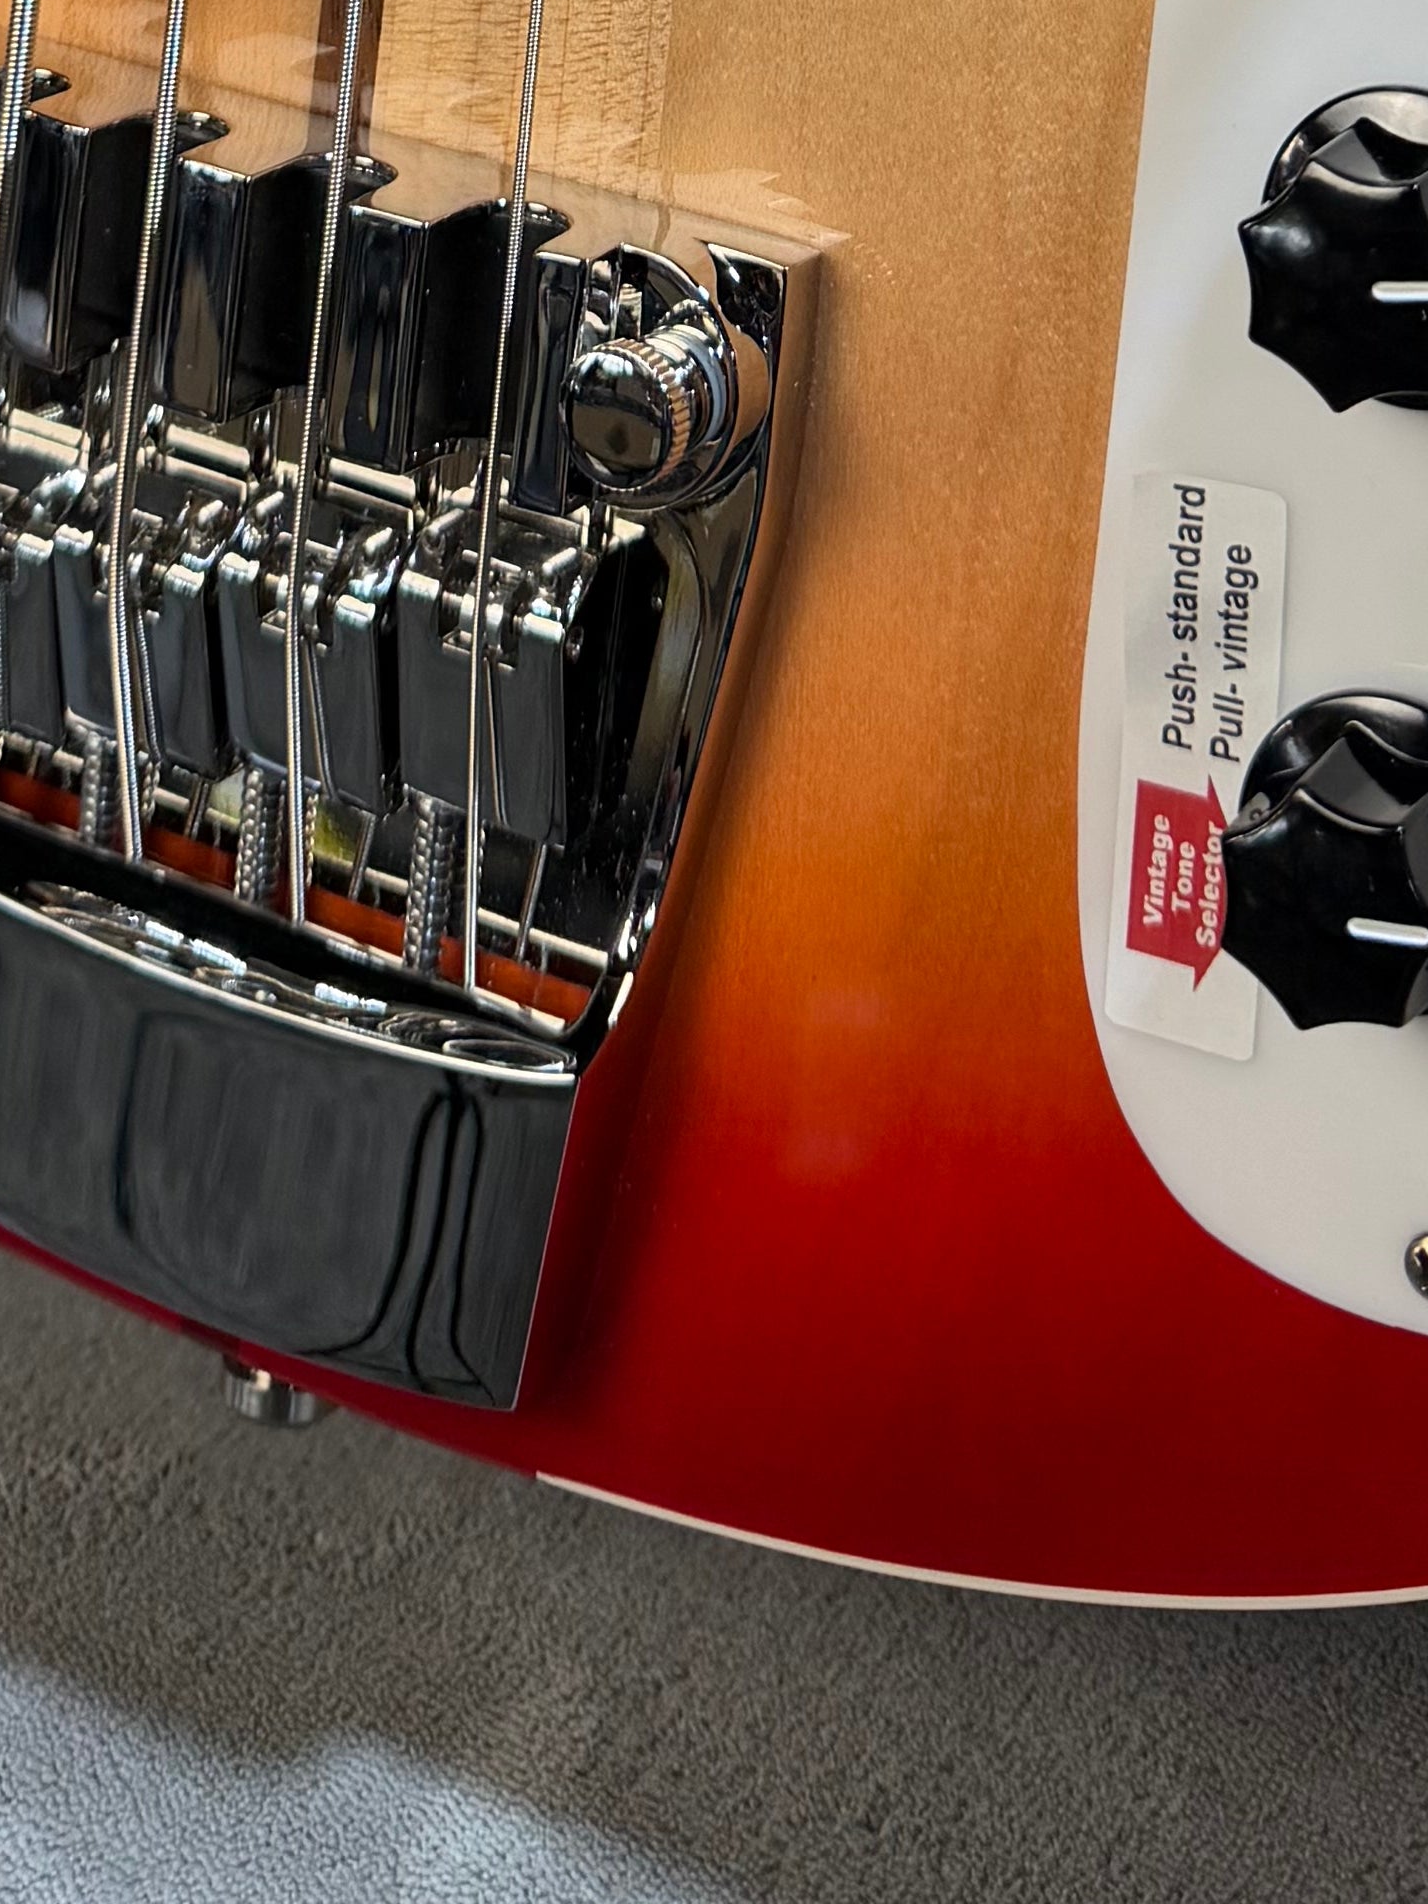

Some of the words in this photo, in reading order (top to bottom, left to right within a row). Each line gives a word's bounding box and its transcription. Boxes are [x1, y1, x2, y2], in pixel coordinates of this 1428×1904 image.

[1166, 483, 1205, 642] standard
[1214, 544, 1259, 670] vintage
[1161, 652, 1197, 750] Push-
[1209, 683, 1244, 762] Pull-
[1143, 814, 1173, 925] Vintage
[1172, 842, 1195, 912] Tone
[1196, 821, 1223, 947] Selector
